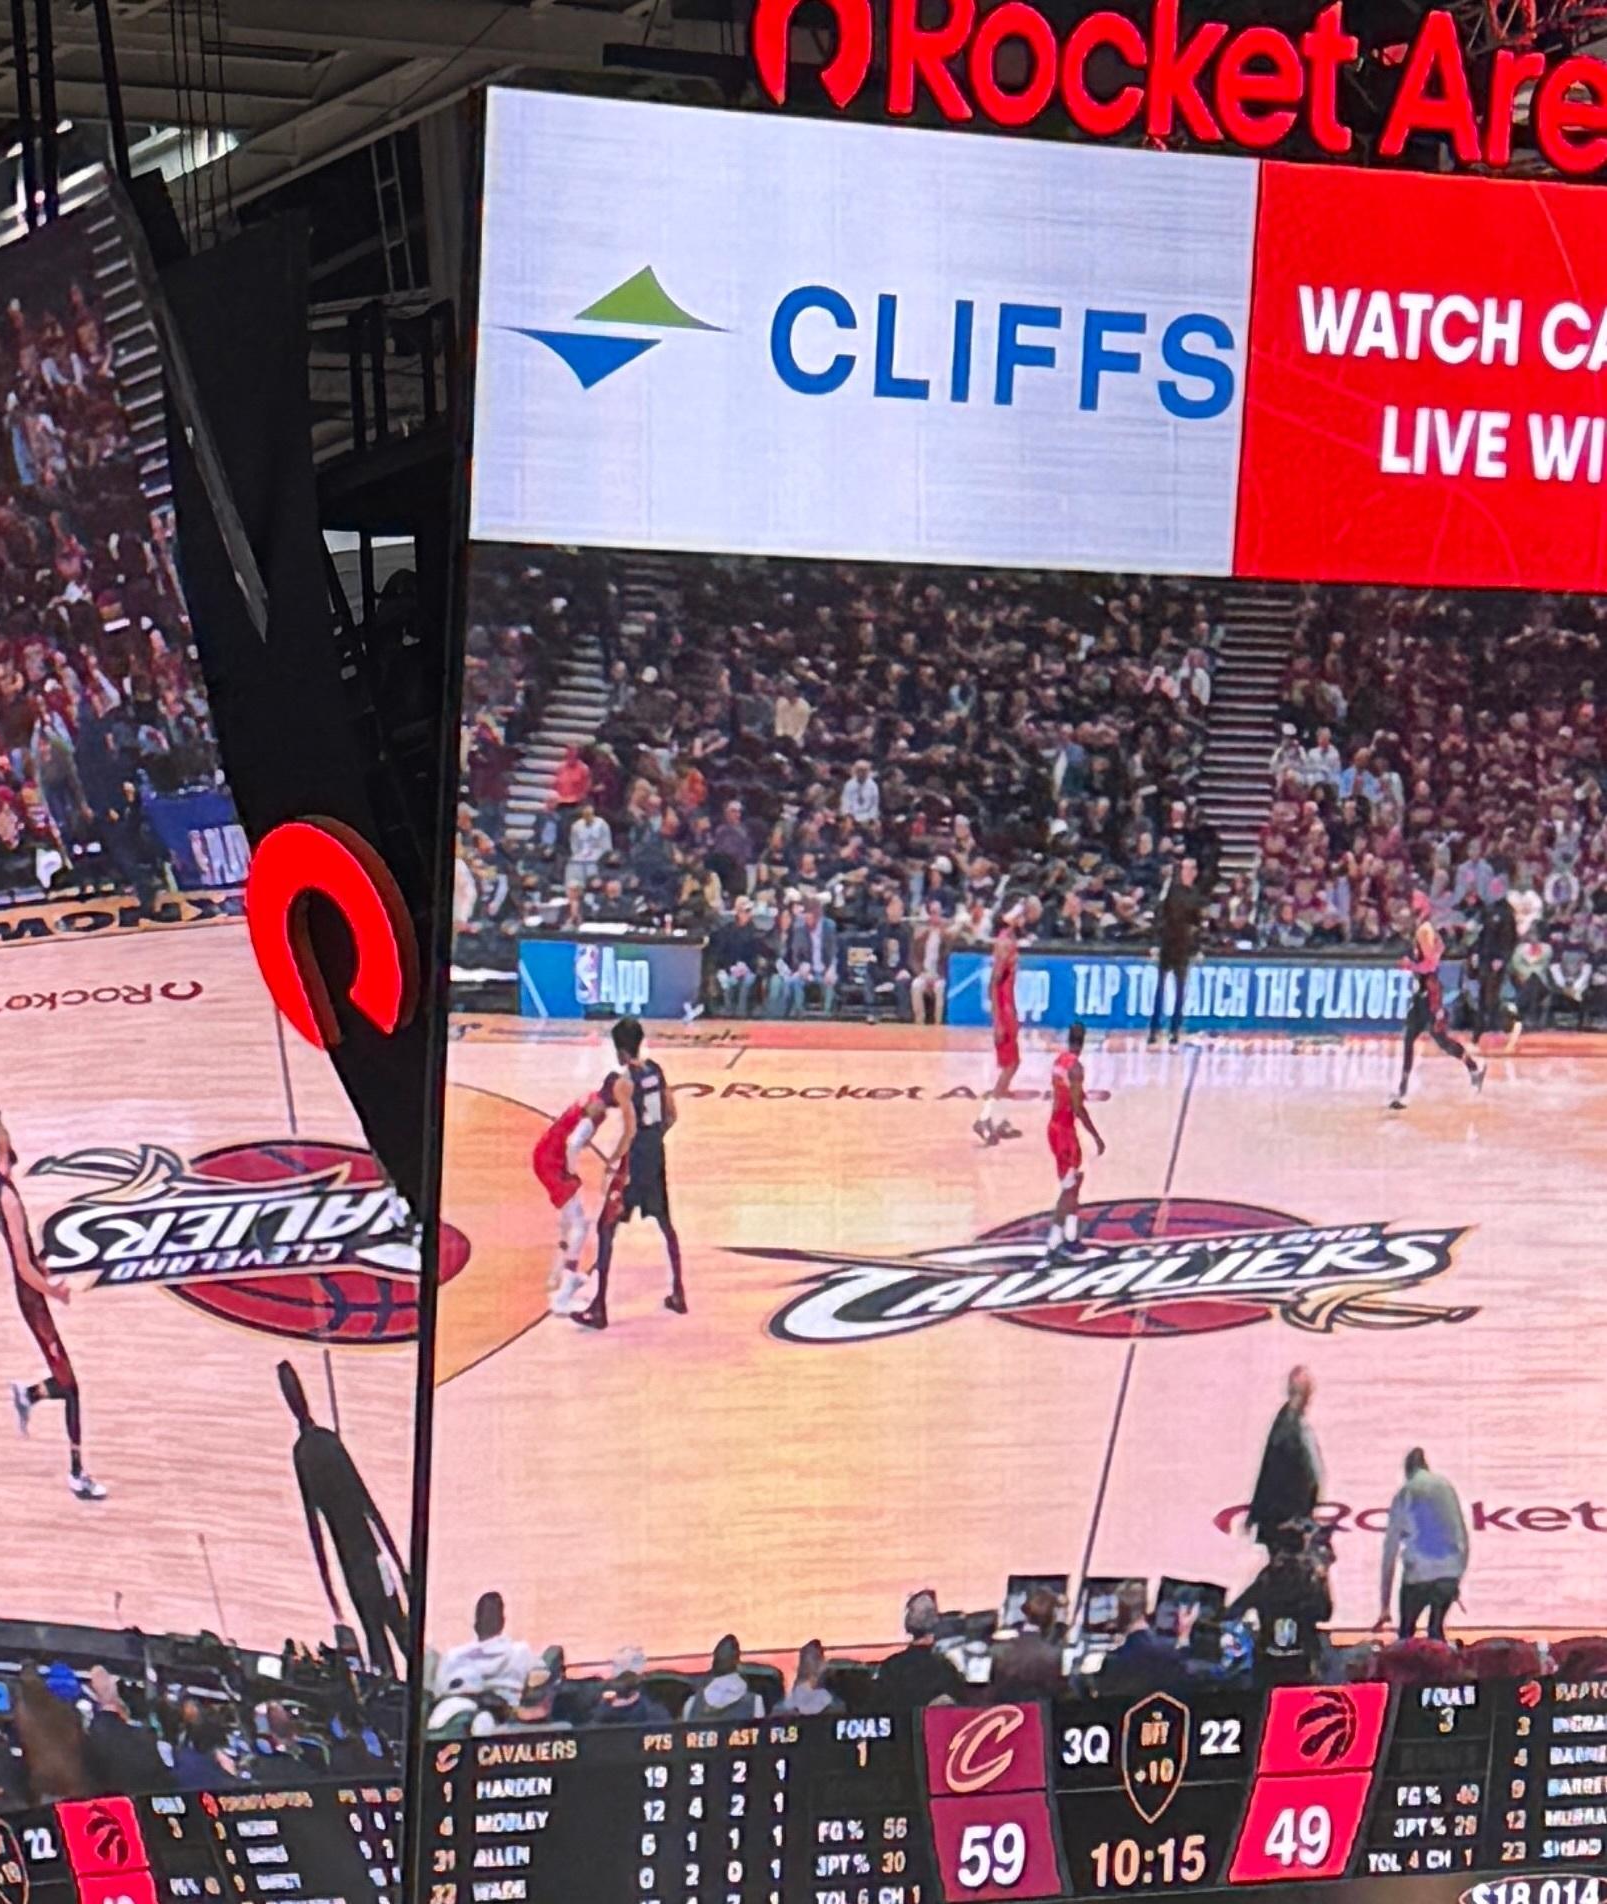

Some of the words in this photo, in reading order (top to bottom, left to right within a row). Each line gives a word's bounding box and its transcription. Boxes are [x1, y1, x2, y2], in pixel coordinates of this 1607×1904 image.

[889, 0, 1358, 153] Rocket
[1299, 286, 1520, 368] WATCH
[770, 286, 1236, 418] CLIFFS
[1381, 408, 1507, 478] LIVE
[1074, 964, 1121, 1015] TAP
[1126, 966, 1158, 1016] TO
[1165, 968, 1251, 1017] ATCH
[1255, 968, 1301, 1018] THE
[1305, 968, 1418, 1021] PLAYOFF
[719, 1082, 924, 1101] Rocket
[111, 1242, 341, 1279] CLEVELAND
[768, 1223, 1474, 1343] CAVALIERS
[1318, 1500, 1607, 1534] Roket
[836, 1717, 891, 1740] FOULS
[1199, 1718, 1242, 1756] 22
[1438, 1707, 1455, 1733] 3
[477, 1740, 578, 1766] CAVALIERS
[857, 1741, 867, 1767] 1
[1062, 1725, 1112, 1765] 3Q
[645, 1765, 668, 1788] 19
[689, 1763, 705, 1786] 3
[732, 1760, 747, 1784] 2
[775, 1758, 786, 1782] 1
[644, 1800, 666, 1822] 12
[689, 1796, 703, 1819] 4
[730, 1794, 745, 1817] 2
[774, 1792, 784, 1813] 1
[23, 1828, 57, 1860] 22
[687, 1830, 698, 1852] 1
[729, 1827, 740, 1850] 1
[772, 1824, 783, 1847] 1
[1264, 1804, 1332, 1868] 49
[881, 1850, 906, 1874] 30
[957, 1821, 1026, 1888] 59
[1091, 1834, 1207, 1888] 10:15
[685, 1863, 699, 1886] 2
[727, 1860, 743, 1883] 0
[771, 1858, 781, 1879] 1
[911, 1885, 921, 1904] 1
